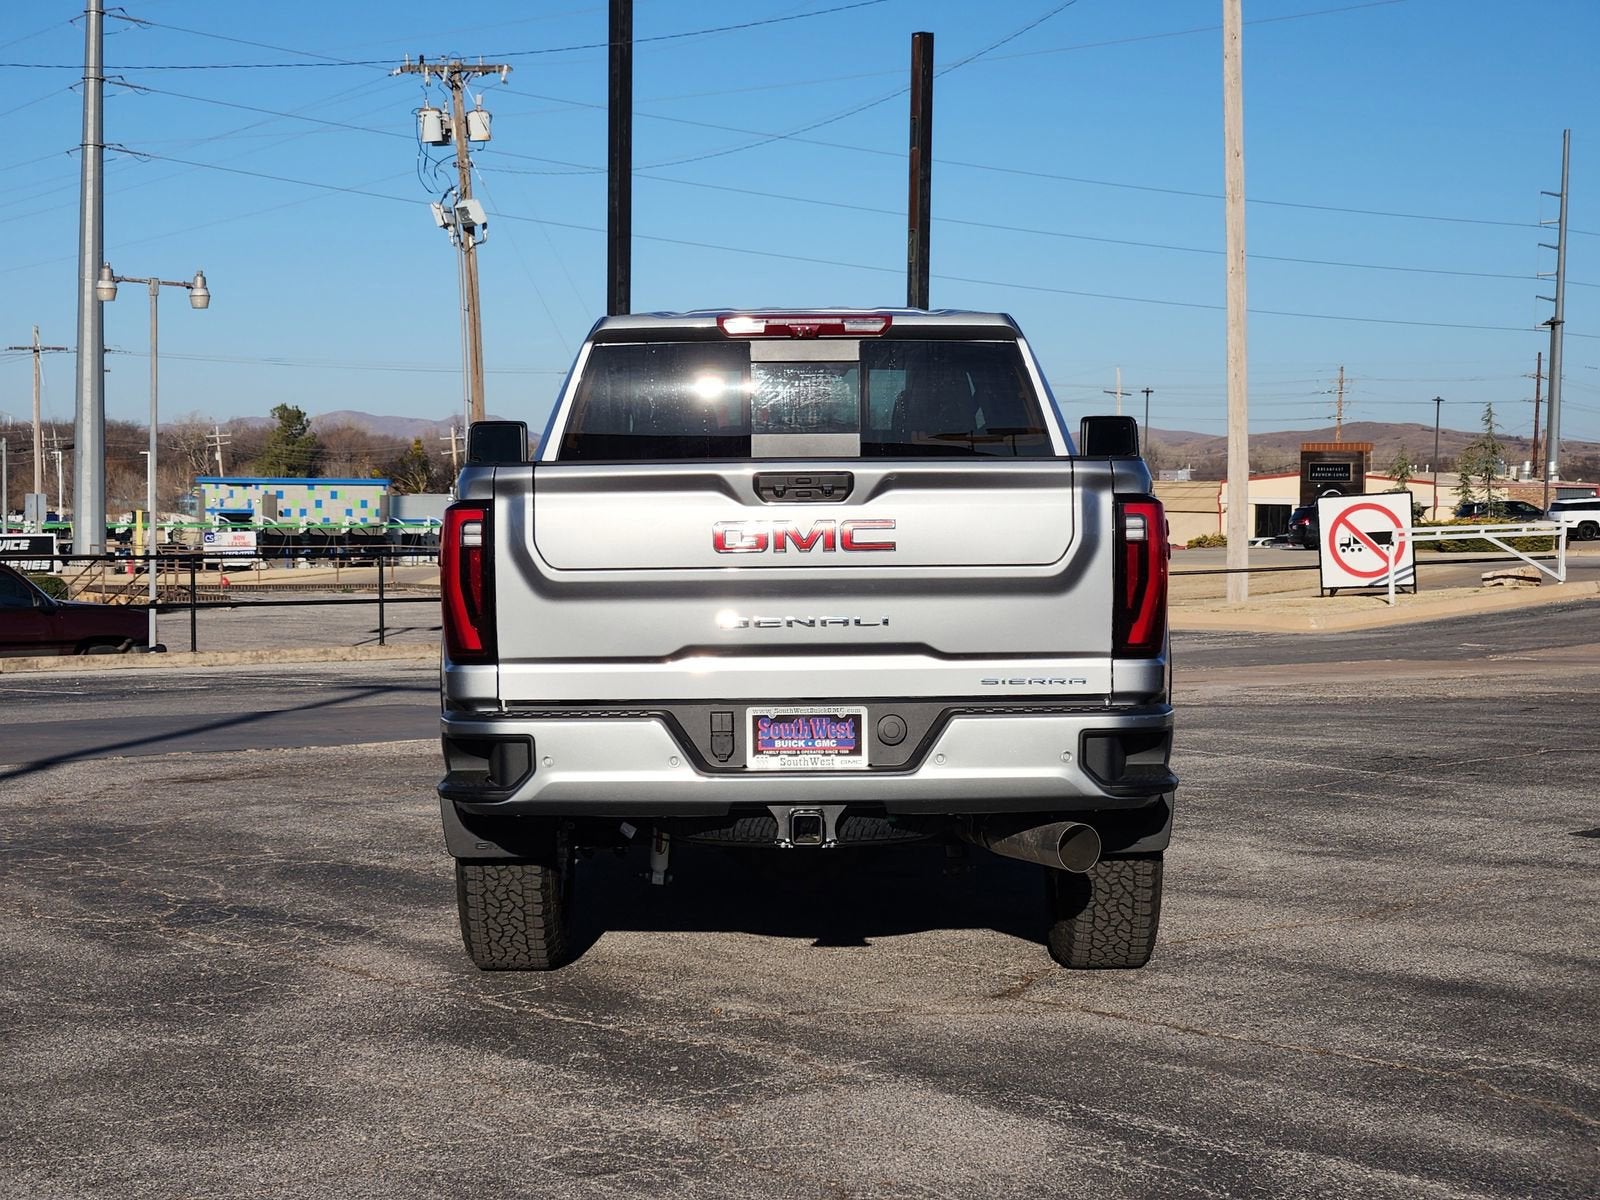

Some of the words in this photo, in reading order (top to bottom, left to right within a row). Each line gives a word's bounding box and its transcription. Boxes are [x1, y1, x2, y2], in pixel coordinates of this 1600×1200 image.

[712, 518, 897, 554] GMC
[980, 678, 1087, 686] SIERRA
[758, 718, 856, 739] SouthWest
[775, 739, 805, 748] BUICK
[814, 739, 837, 748] GMC
[779, 756, 835, 767] SouthWest
